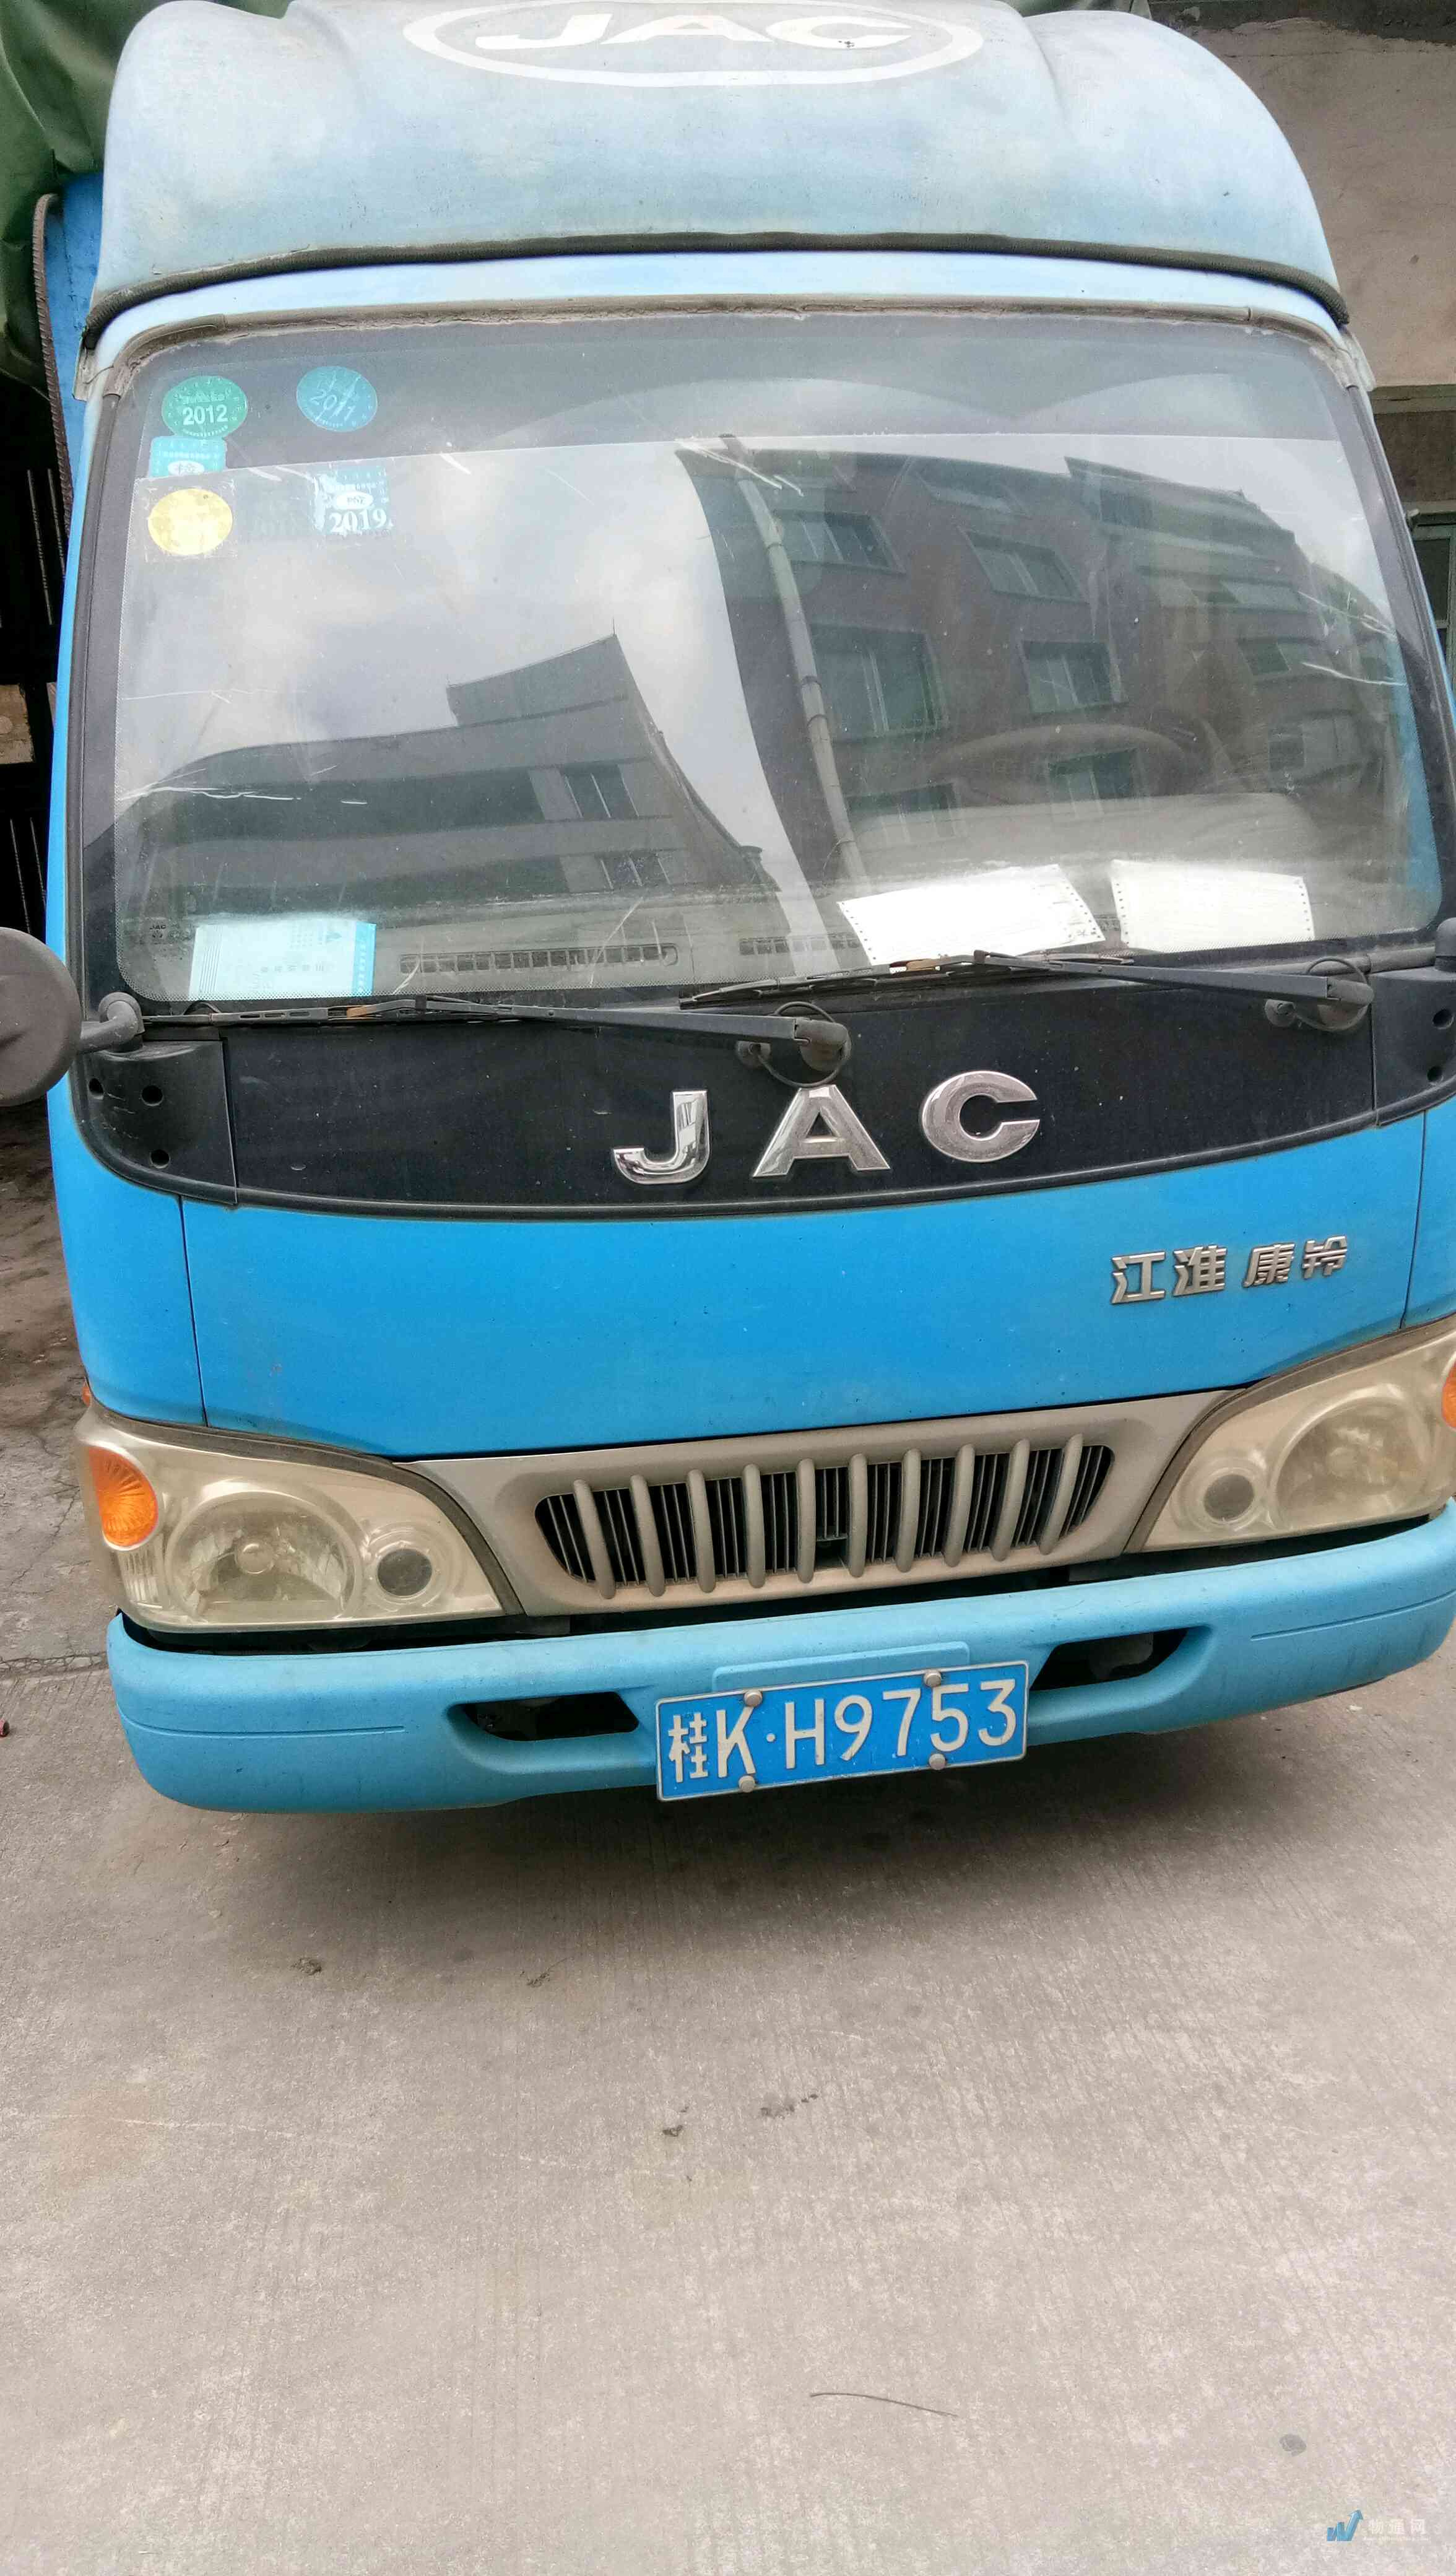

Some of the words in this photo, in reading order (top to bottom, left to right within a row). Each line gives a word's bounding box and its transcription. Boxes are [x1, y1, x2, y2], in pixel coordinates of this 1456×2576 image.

[475, 13, 914, 50] JAC
[182, 404, 228, 425] 2012
[329, 508, 387, 533] 2019
[611, 1069, 1041, 1185] JAC
[1111, 1245, 1228, 1305] 江淮
[1241, 1234, 1348, 1288] 康铃
